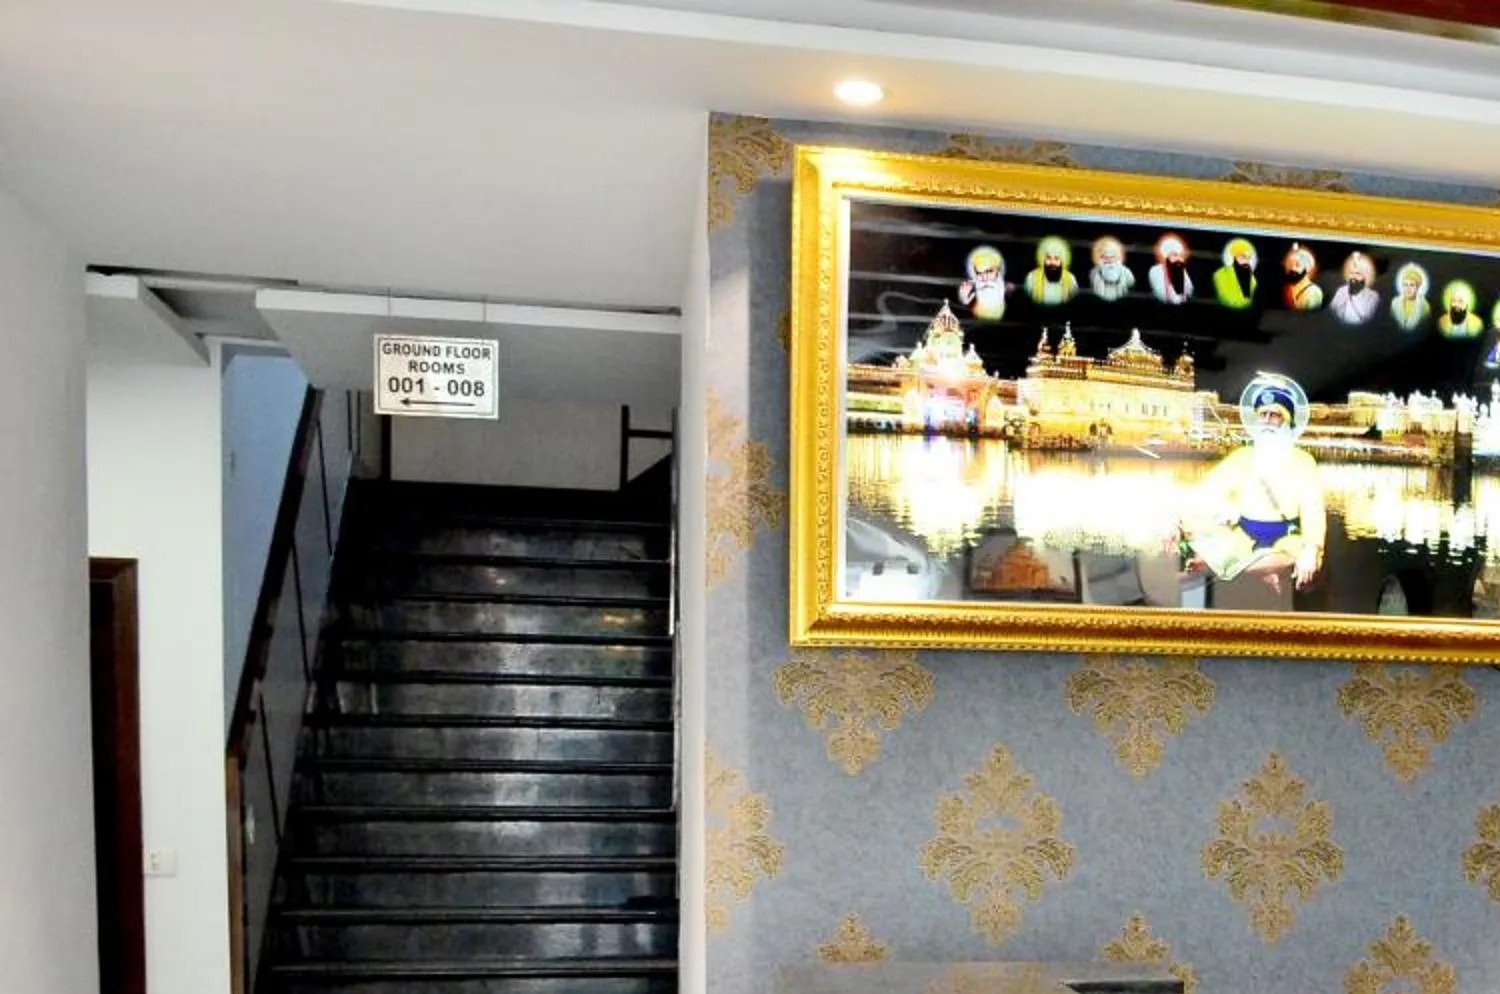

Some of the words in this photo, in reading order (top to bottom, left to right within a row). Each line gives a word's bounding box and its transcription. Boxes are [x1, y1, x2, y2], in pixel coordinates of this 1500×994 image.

[382, 343, 441, 357] GROUND
[446, 346, 491, 360] FLOOR
[408, 361, 466, 375] ROOMS
[388, 376, 425, 394] 001
[447, 379, 485, 397] 008
